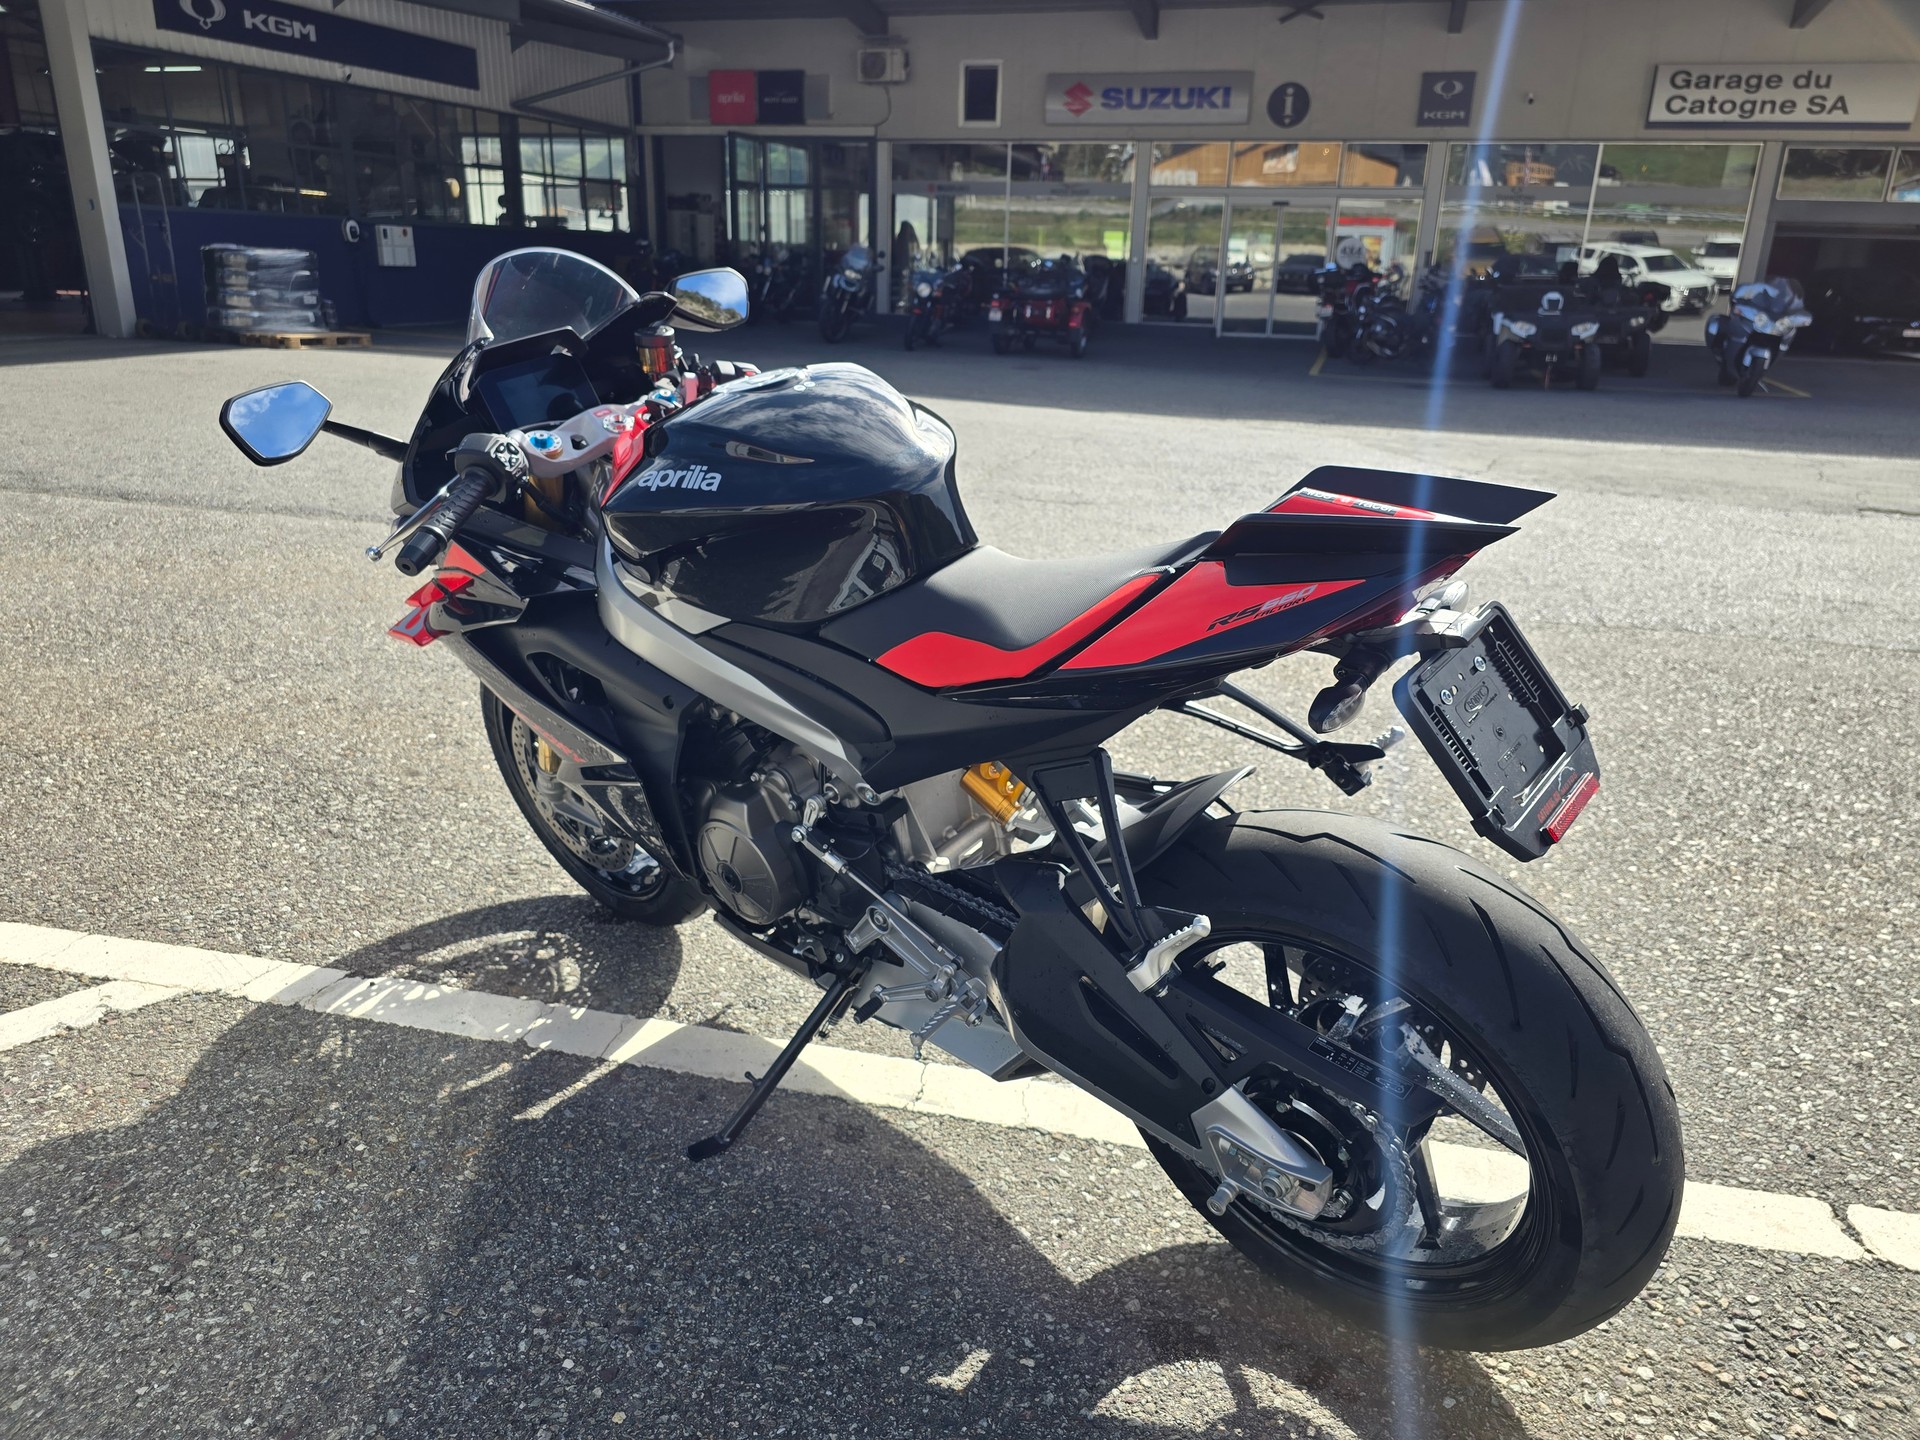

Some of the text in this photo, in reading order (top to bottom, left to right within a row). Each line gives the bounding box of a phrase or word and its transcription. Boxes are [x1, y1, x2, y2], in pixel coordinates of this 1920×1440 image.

[243, 9, 317, 42] KGM
[1669, 69, 1832, 95] Garage du
[1101, 86, 1232, 110] SUZUKI
[1664, 95, 1850, 119] Catogne SA
[1423, 110, 1466, 120] KGM
[637, 464, 722, 492] aprilia
[1253, 595, 1309, 619] FACTORY
